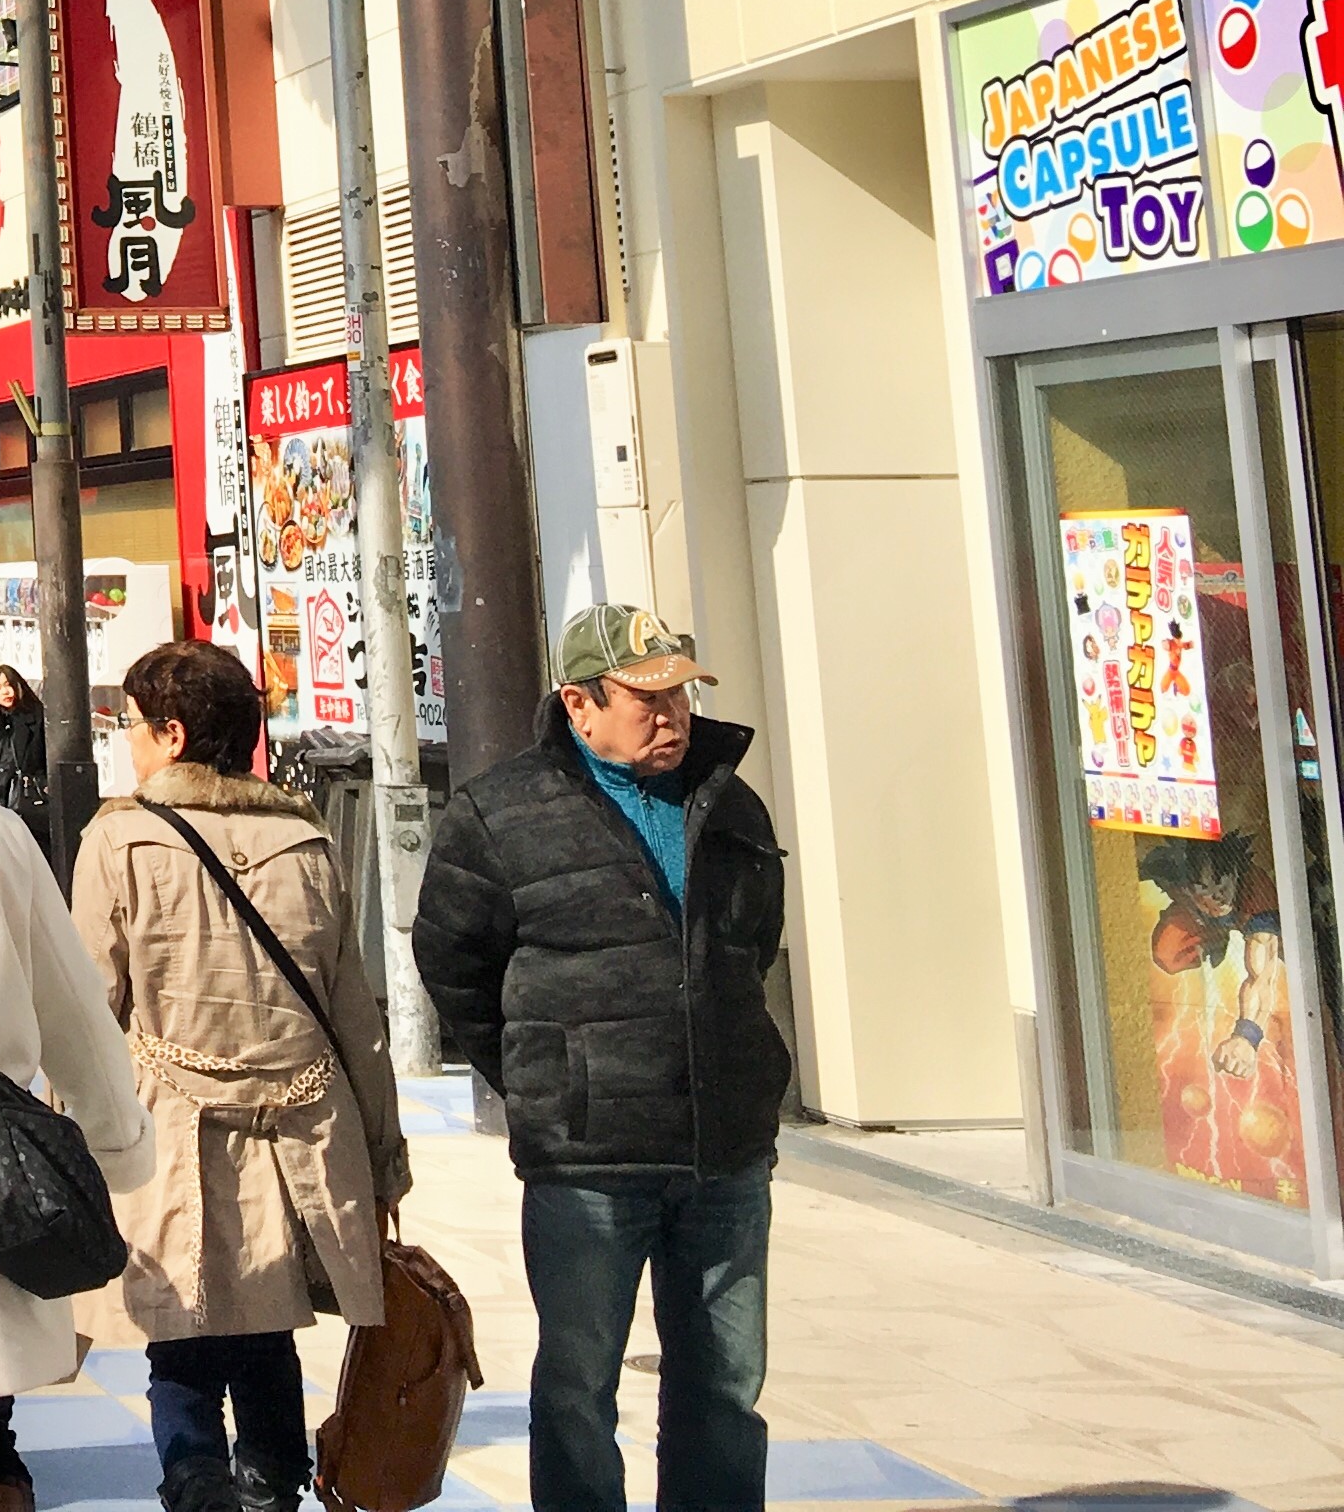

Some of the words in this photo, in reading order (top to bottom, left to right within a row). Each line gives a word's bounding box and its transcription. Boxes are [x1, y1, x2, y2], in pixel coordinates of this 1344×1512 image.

[130, 111, 160, 169] 鶴橋
[162, 115, 177, 192] FUGETSU
[1002, 92, 1194, 210] CAPSULE
[91, 169, 196, 299] 風月
[1100, 184, 1198, 249] TOY
[213, 398, 236, 507] 鶴橋
[234, 401, 249, 554] FUGETSU
[1156, 526, 1174, 611] 人気の
[1122, 523, 1157, 768] ガチャガチャ
